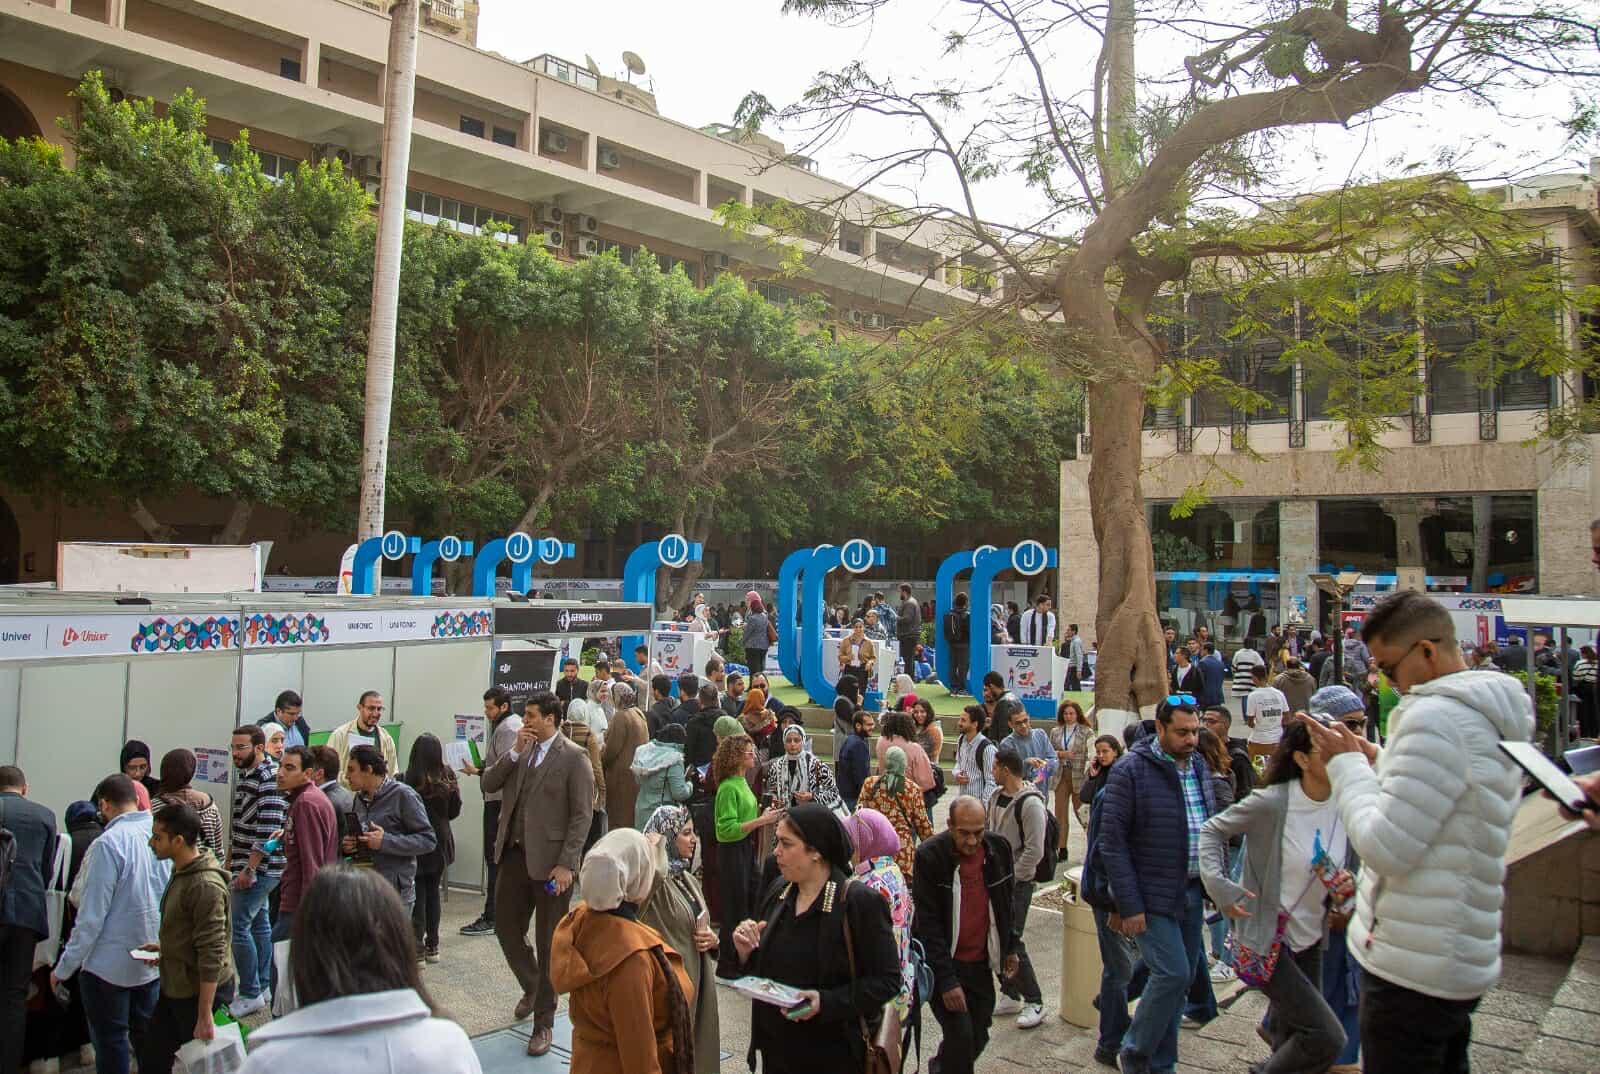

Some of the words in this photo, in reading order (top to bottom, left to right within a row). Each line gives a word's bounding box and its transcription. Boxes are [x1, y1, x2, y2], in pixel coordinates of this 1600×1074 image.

[347, 622, 374, 630] UNIFONIC
[388, 620, 417, 630] UNIFONIC
[1, 630, 32, 642] Univer
[81, 629, 110, 643] Univer
